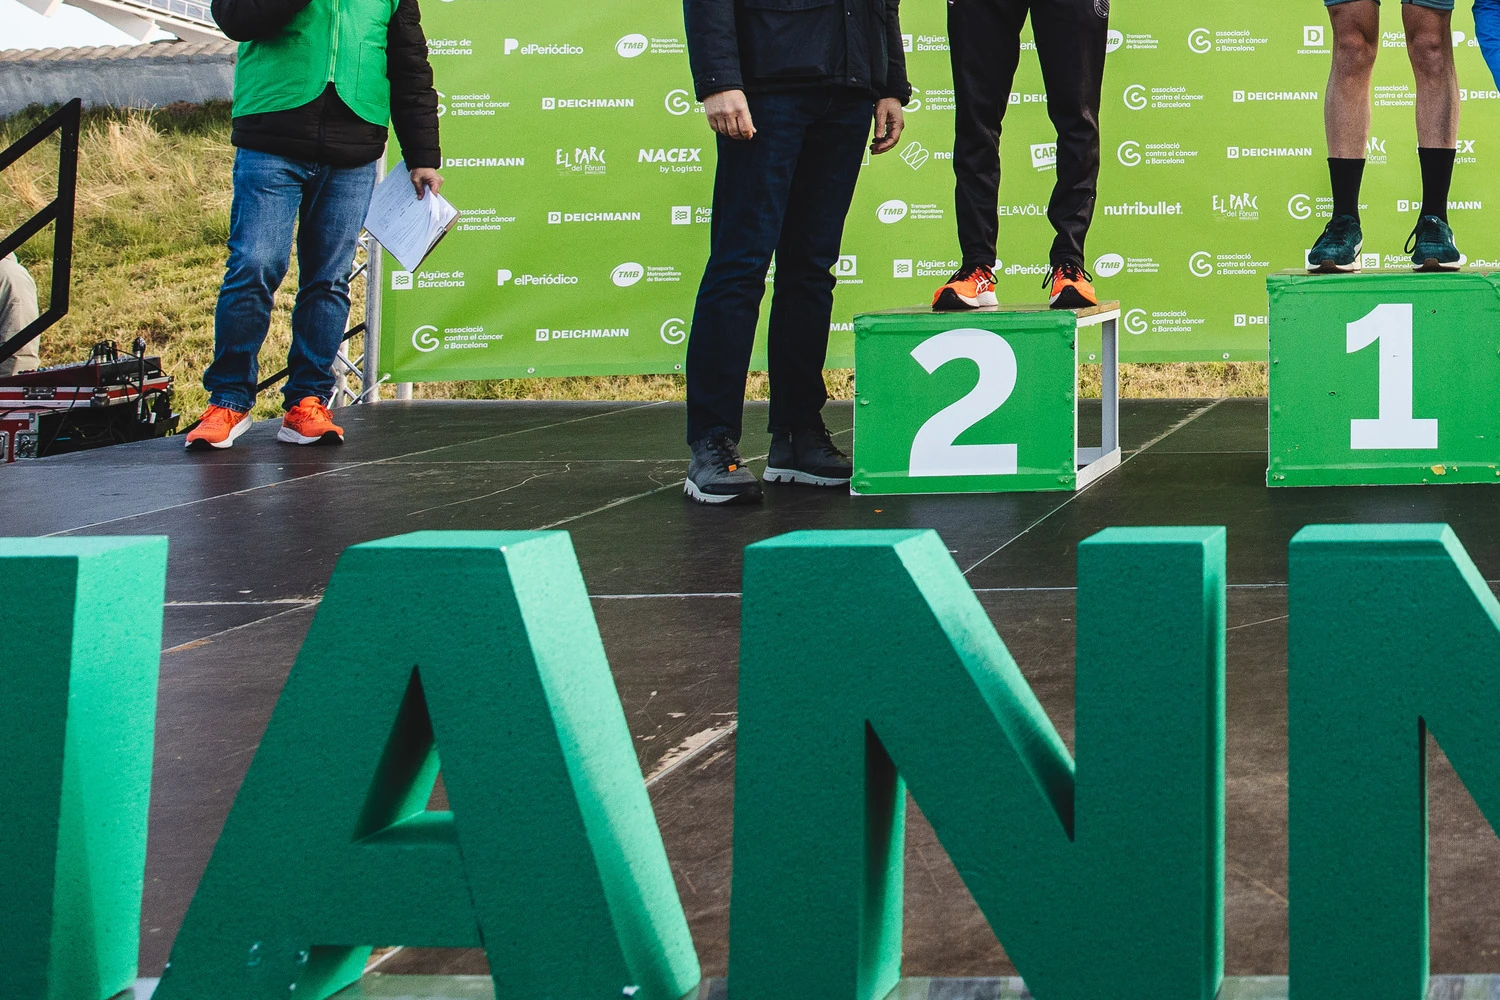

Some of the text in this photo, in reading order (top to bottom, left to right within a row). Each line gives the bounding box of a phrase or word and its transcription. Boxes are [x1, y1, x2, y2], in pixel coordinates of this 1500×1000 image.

[520, 44, 583, 54] elPeriódico
[558, 99, 634, 107] DEICHMANN
[1242, 148, 1312, 156] DEICHMANN
[564, 212, 640, 222] DEICHMANN
[418, 271, 448, 280] Aigües
[418, 278, 465, 288] Barcelona
[552, 328, 629, 339] DEICHMANN
[1346, 303, 1438, 449] 1
[907, 328, 1017, 477] 2
